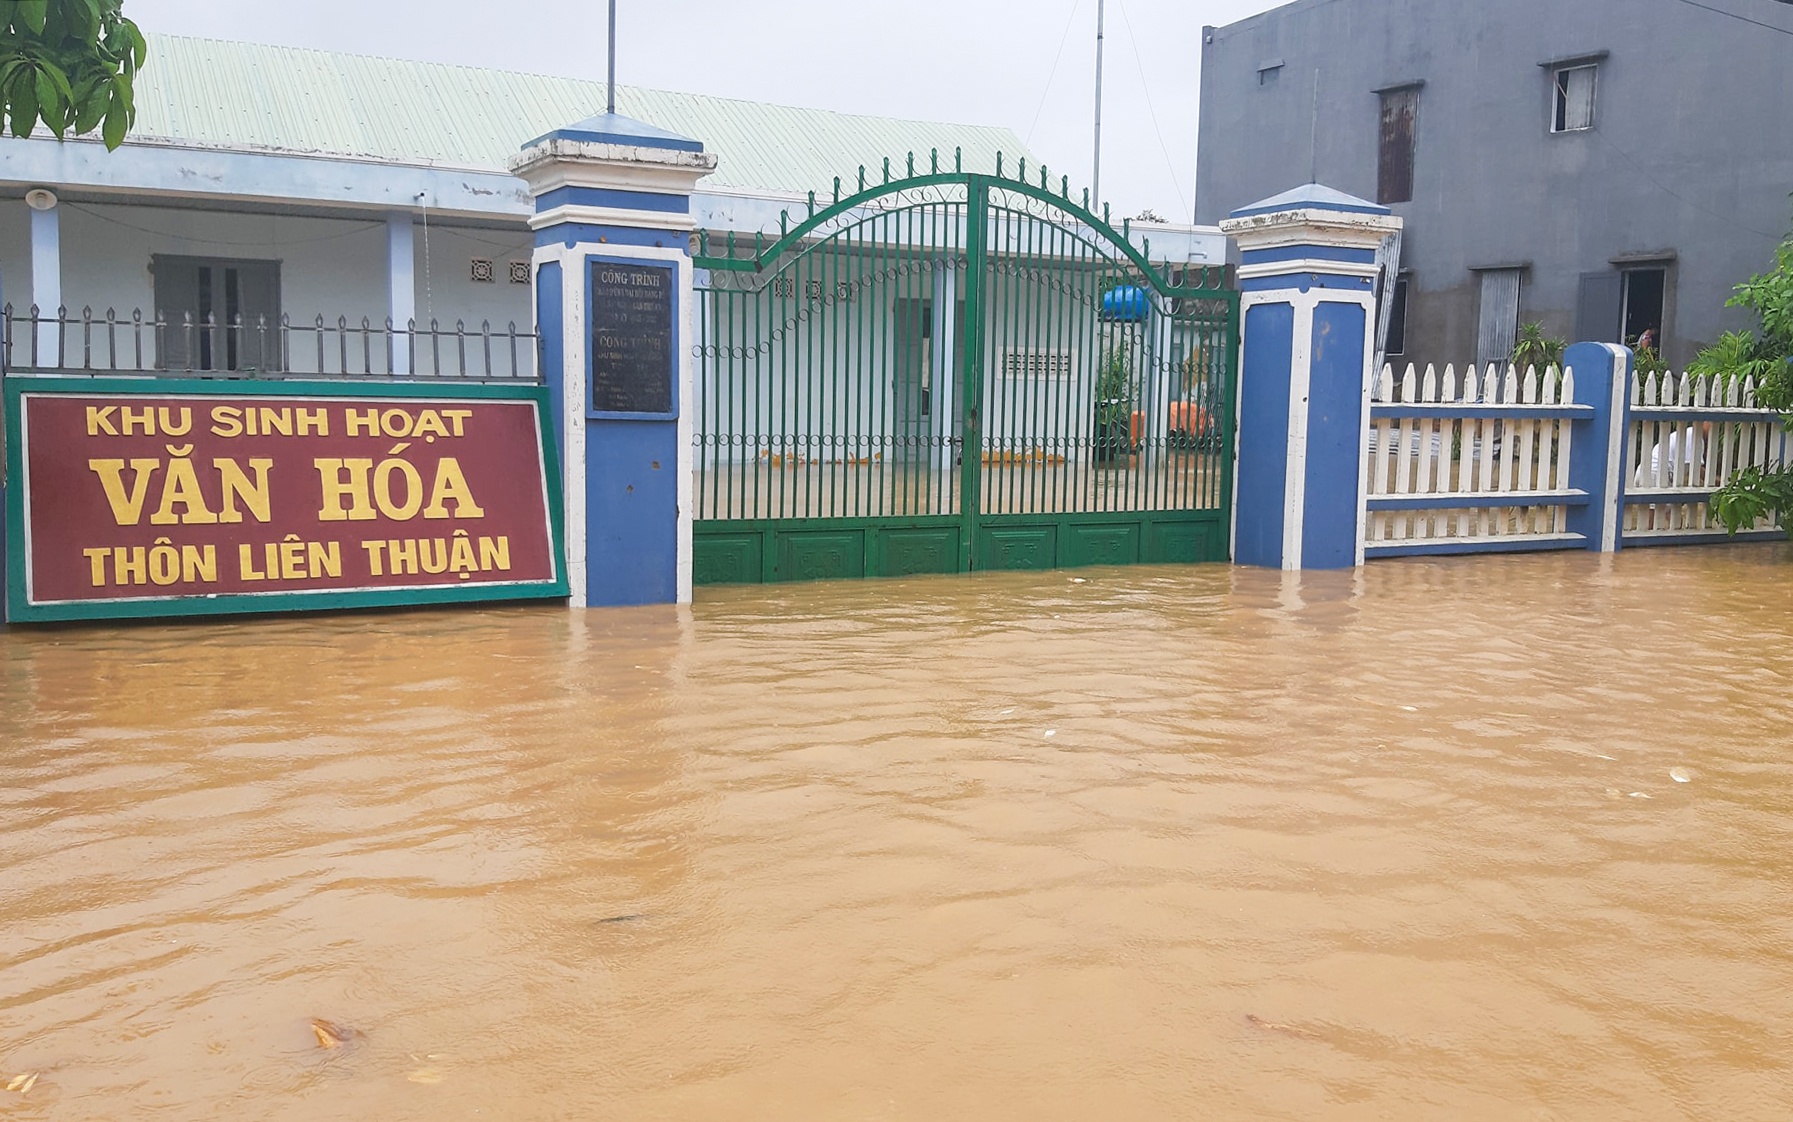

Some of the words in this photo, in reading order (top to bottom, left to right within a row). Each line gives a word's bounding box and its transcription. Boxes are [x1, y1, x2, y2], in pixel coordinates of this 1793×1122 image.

[601, 269, 628, 285] CÔNG
[631, 271, 660, 287] TRÌNH
[86, 405, 193, 437] KHU
[210, 406, 329, 438] SINH
[346, 408, 473, 443] HOẠT
[88, 443, 274, 526] VĂN
[314, 442, 485, 522] HÓA
[83, 537, 217, 587] THÔN
[239, 534, 342, 581] LIÊN
[361, 529, 511, 579] THUẬN
